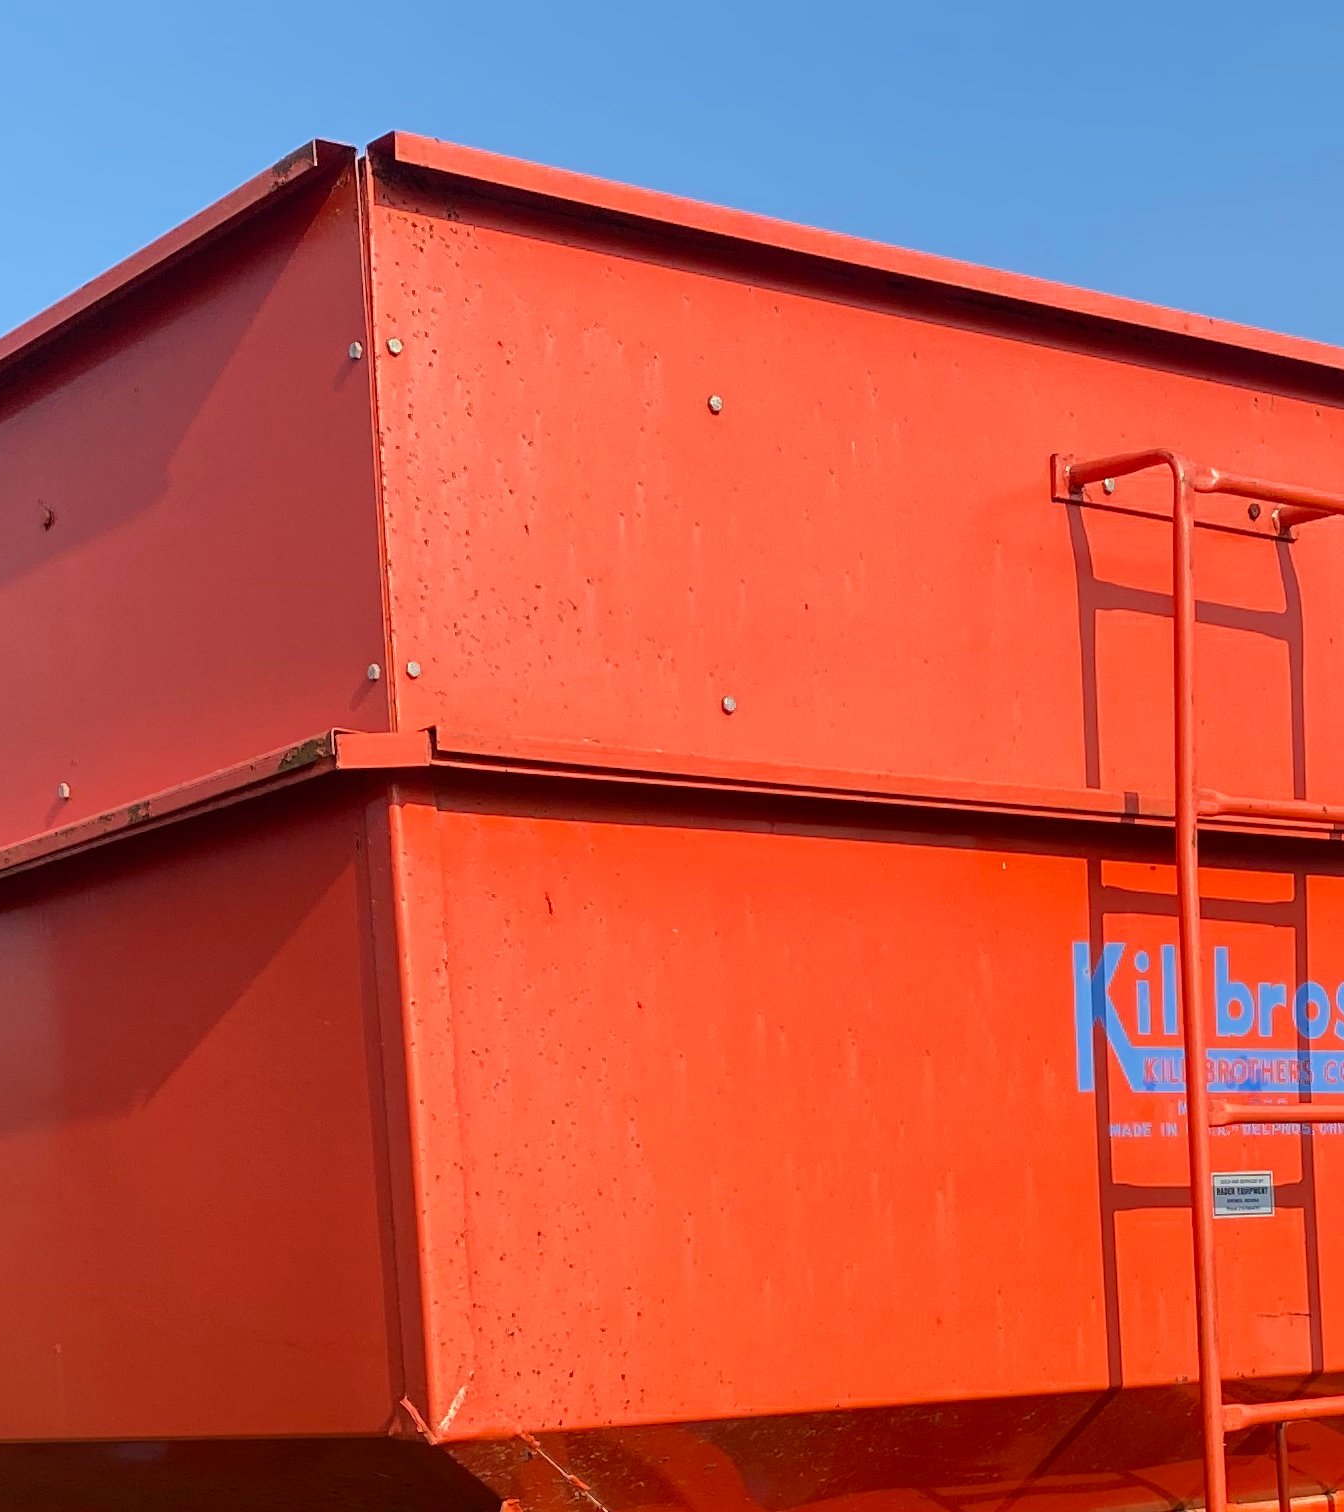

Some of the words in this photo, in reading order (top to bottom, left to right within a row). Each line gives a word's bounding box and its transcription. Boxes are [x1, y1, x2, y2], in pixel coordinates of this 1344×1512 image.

[1205, 1057, 1313, 1085] BROTHERS
[1110, 1122, 1152, 1137] MADE
[1160, 1122, 1178, 1138] IN
